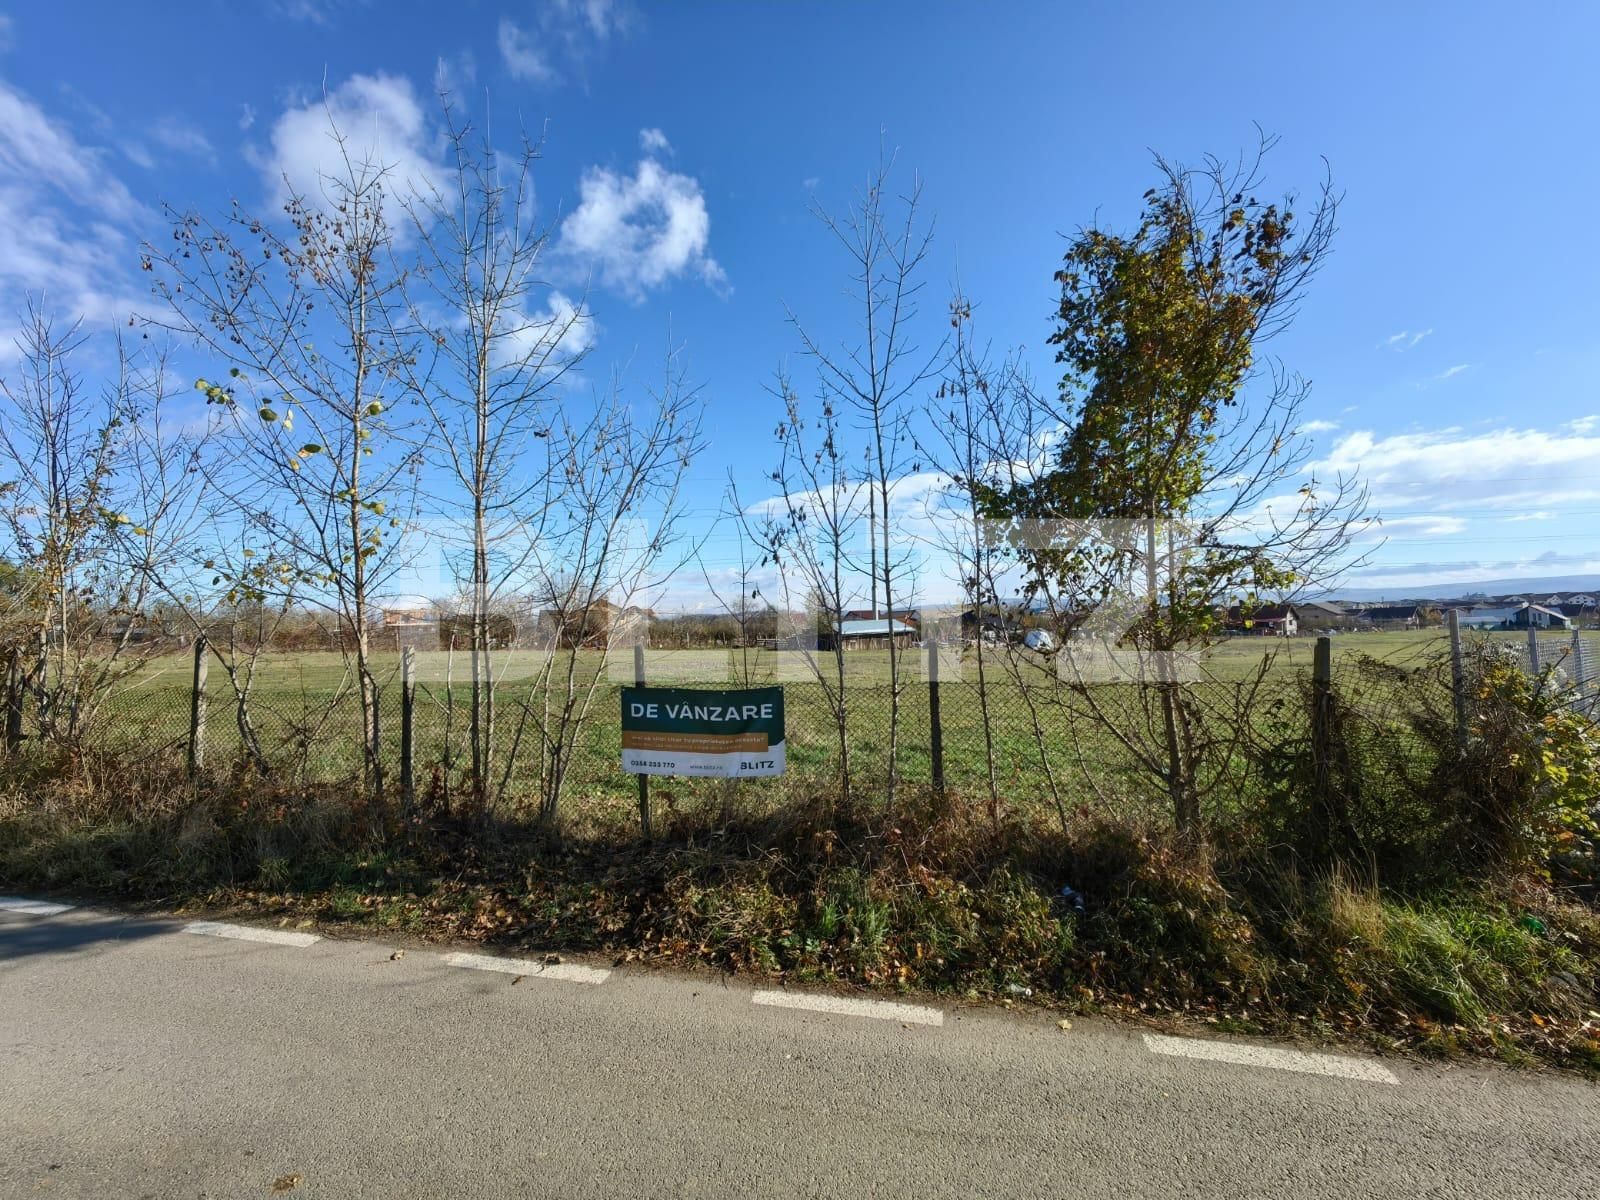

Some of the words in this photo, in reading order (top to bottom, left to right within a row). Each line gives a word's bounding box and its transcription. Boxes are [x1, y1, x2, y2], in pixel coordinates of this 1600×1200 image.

[630, 703, 659, 718] DE
[665, 701, 773, 721] VÂNZARE
[740, 760, 775, 770] BLITZ
